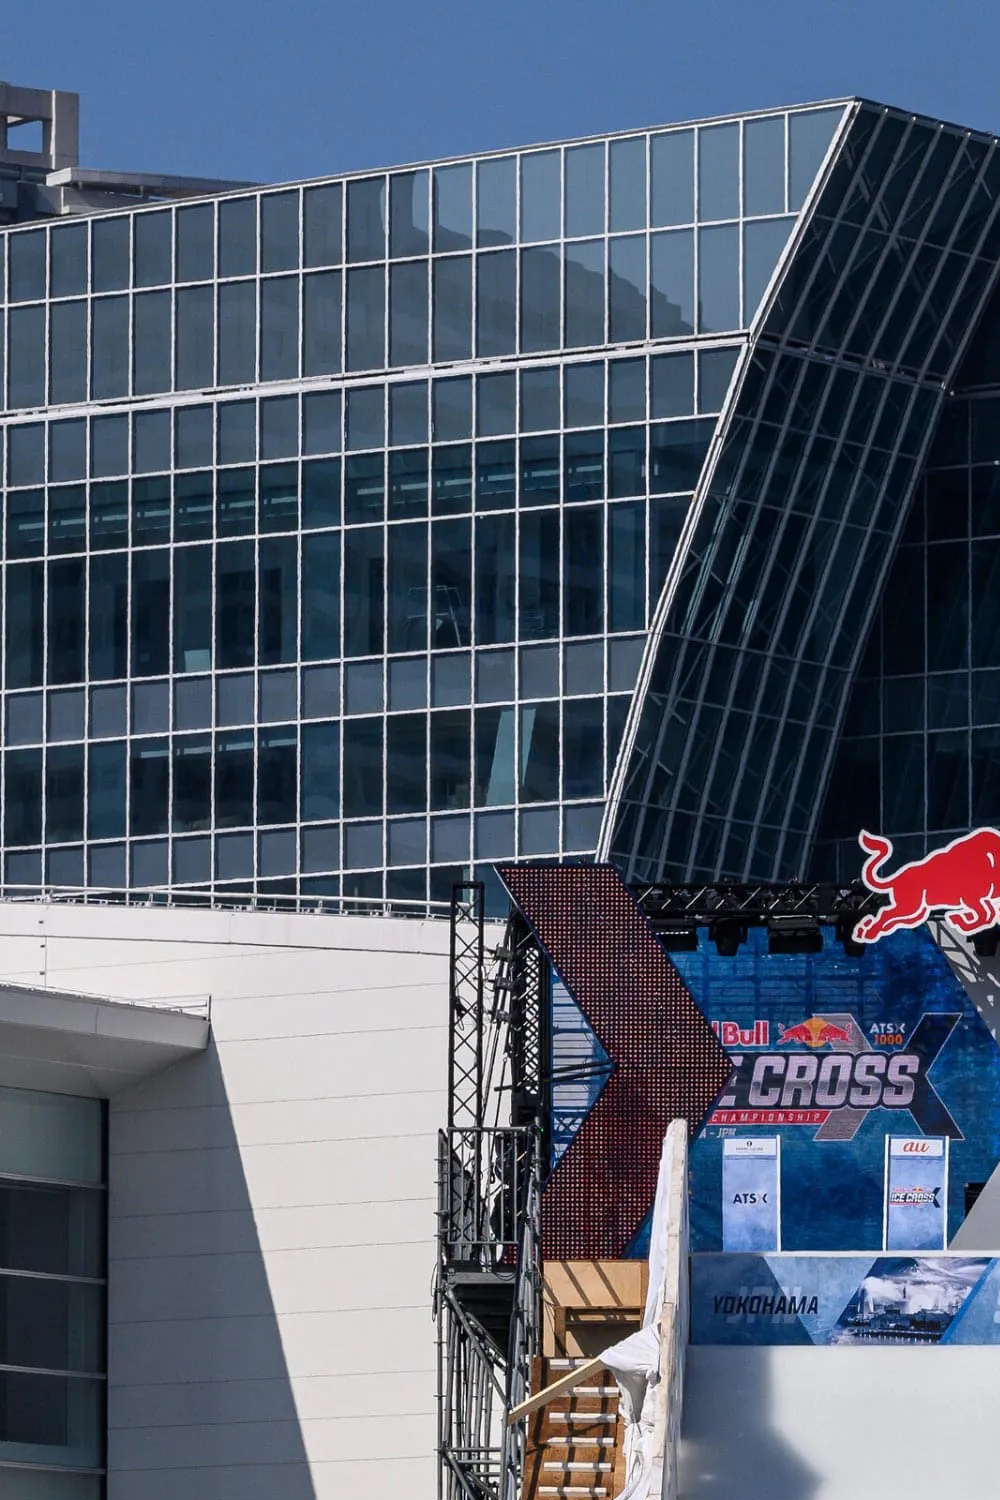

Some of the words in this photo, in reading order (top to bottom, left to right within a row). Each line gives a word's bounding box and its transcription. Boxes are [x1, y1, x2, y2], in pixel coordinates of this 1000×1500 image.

[722, 1021, 769, 1046] Bull
[874, 1034, 903, 1045] 1000
[749, 1055, 920, 1107] CROSS
[711, 1112, 821, 1123] CHAMPIONSHIP
[903, 1141, 929, 1153] au
[713, 1296, 818, 1315] YOKOHAMA
